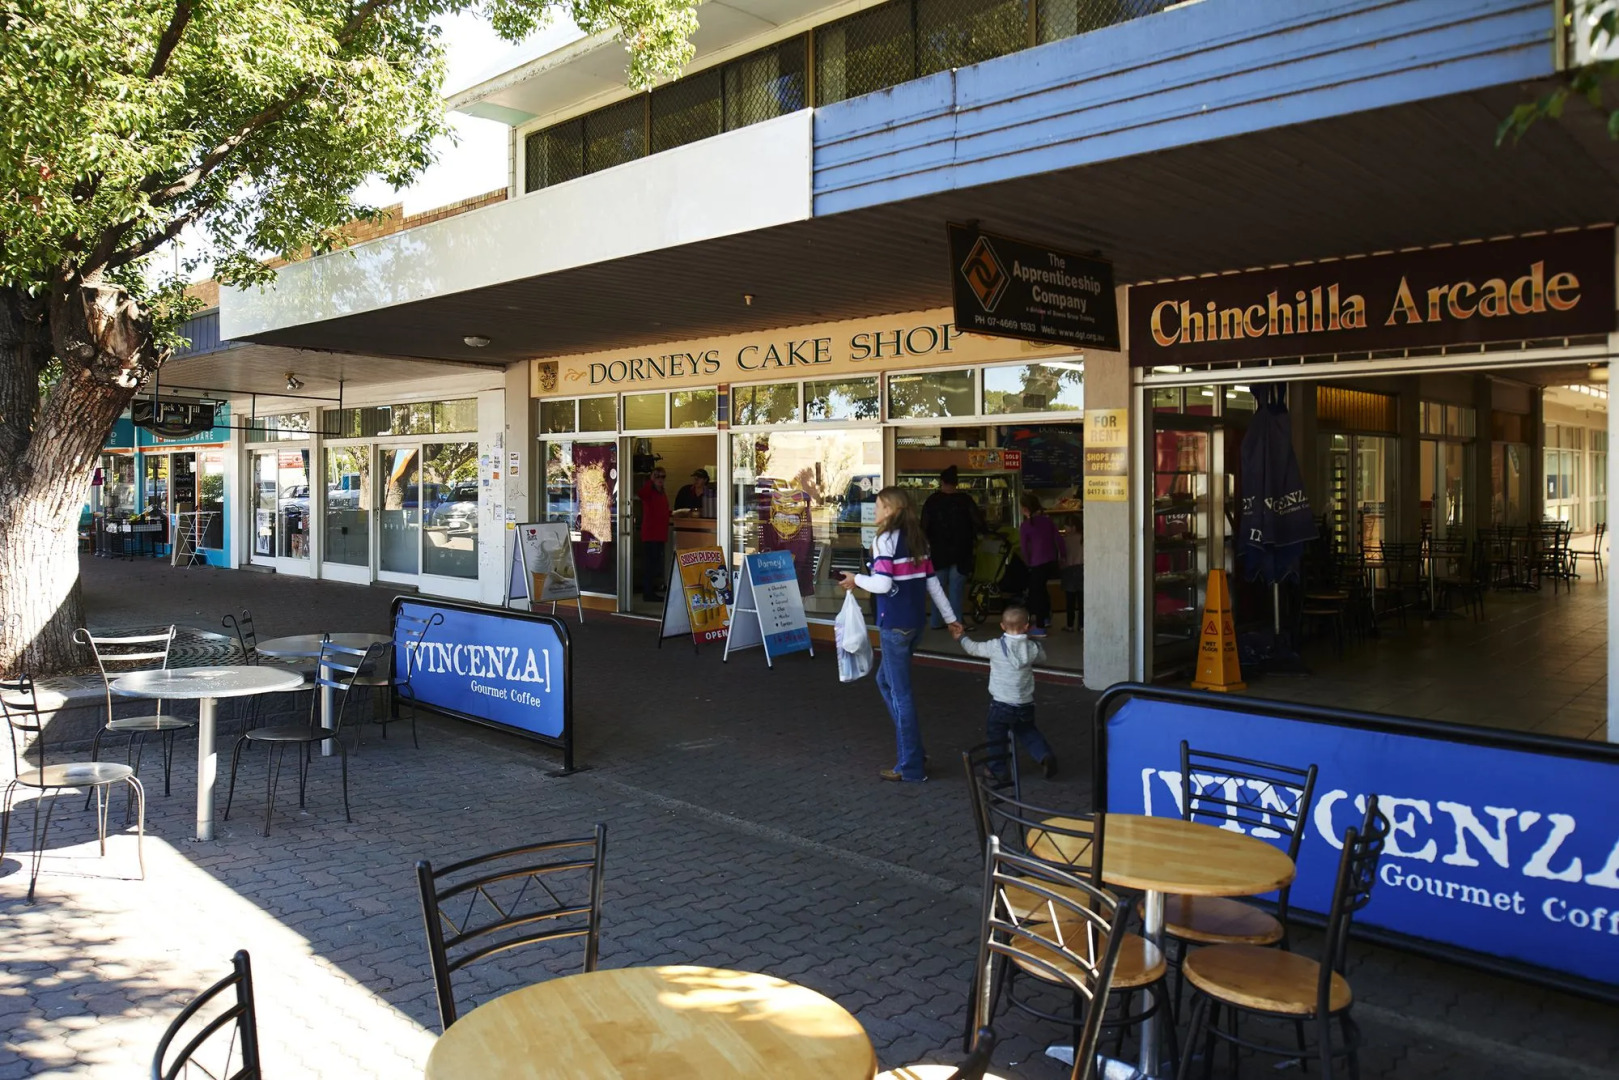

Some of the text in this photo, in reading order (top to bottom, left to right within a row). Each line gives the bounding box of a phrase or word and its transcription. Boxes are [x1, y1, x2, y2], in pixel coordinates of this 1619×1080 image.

[1048, 252, 1066, 269] The
[1012, 260, 1101, 296] Apprenticeship
[1031, 285, 1088, 314] Company
[1149, 260, 1582, 347] Chinchilla Arcade
[974, 315, 986, 325] PH
[987, 317, 1018, 330] 07-4669
[1019, 321, 1037, 333] 1533
[588, 322, 964, 386] DORNEYS CAKE SHOP
[156, 402, 175, 423] Jack
[185, 404, 200, 424] Jill
[1093, 415, 1117, 428] FOR
[1090, 429, 1121, 442] RENT
[1086, 452, 1125, 462] SHOPS AND
[1091, 462, 1121, 471] OFFICES
[680, 550, 721, 567] SLUSH PUPPIE
[705, 629, 728, 640] OPEN
[470, 680, 541, 708] Gourmet Coffee
[1379, 863, 1527, 915] Gourmet
